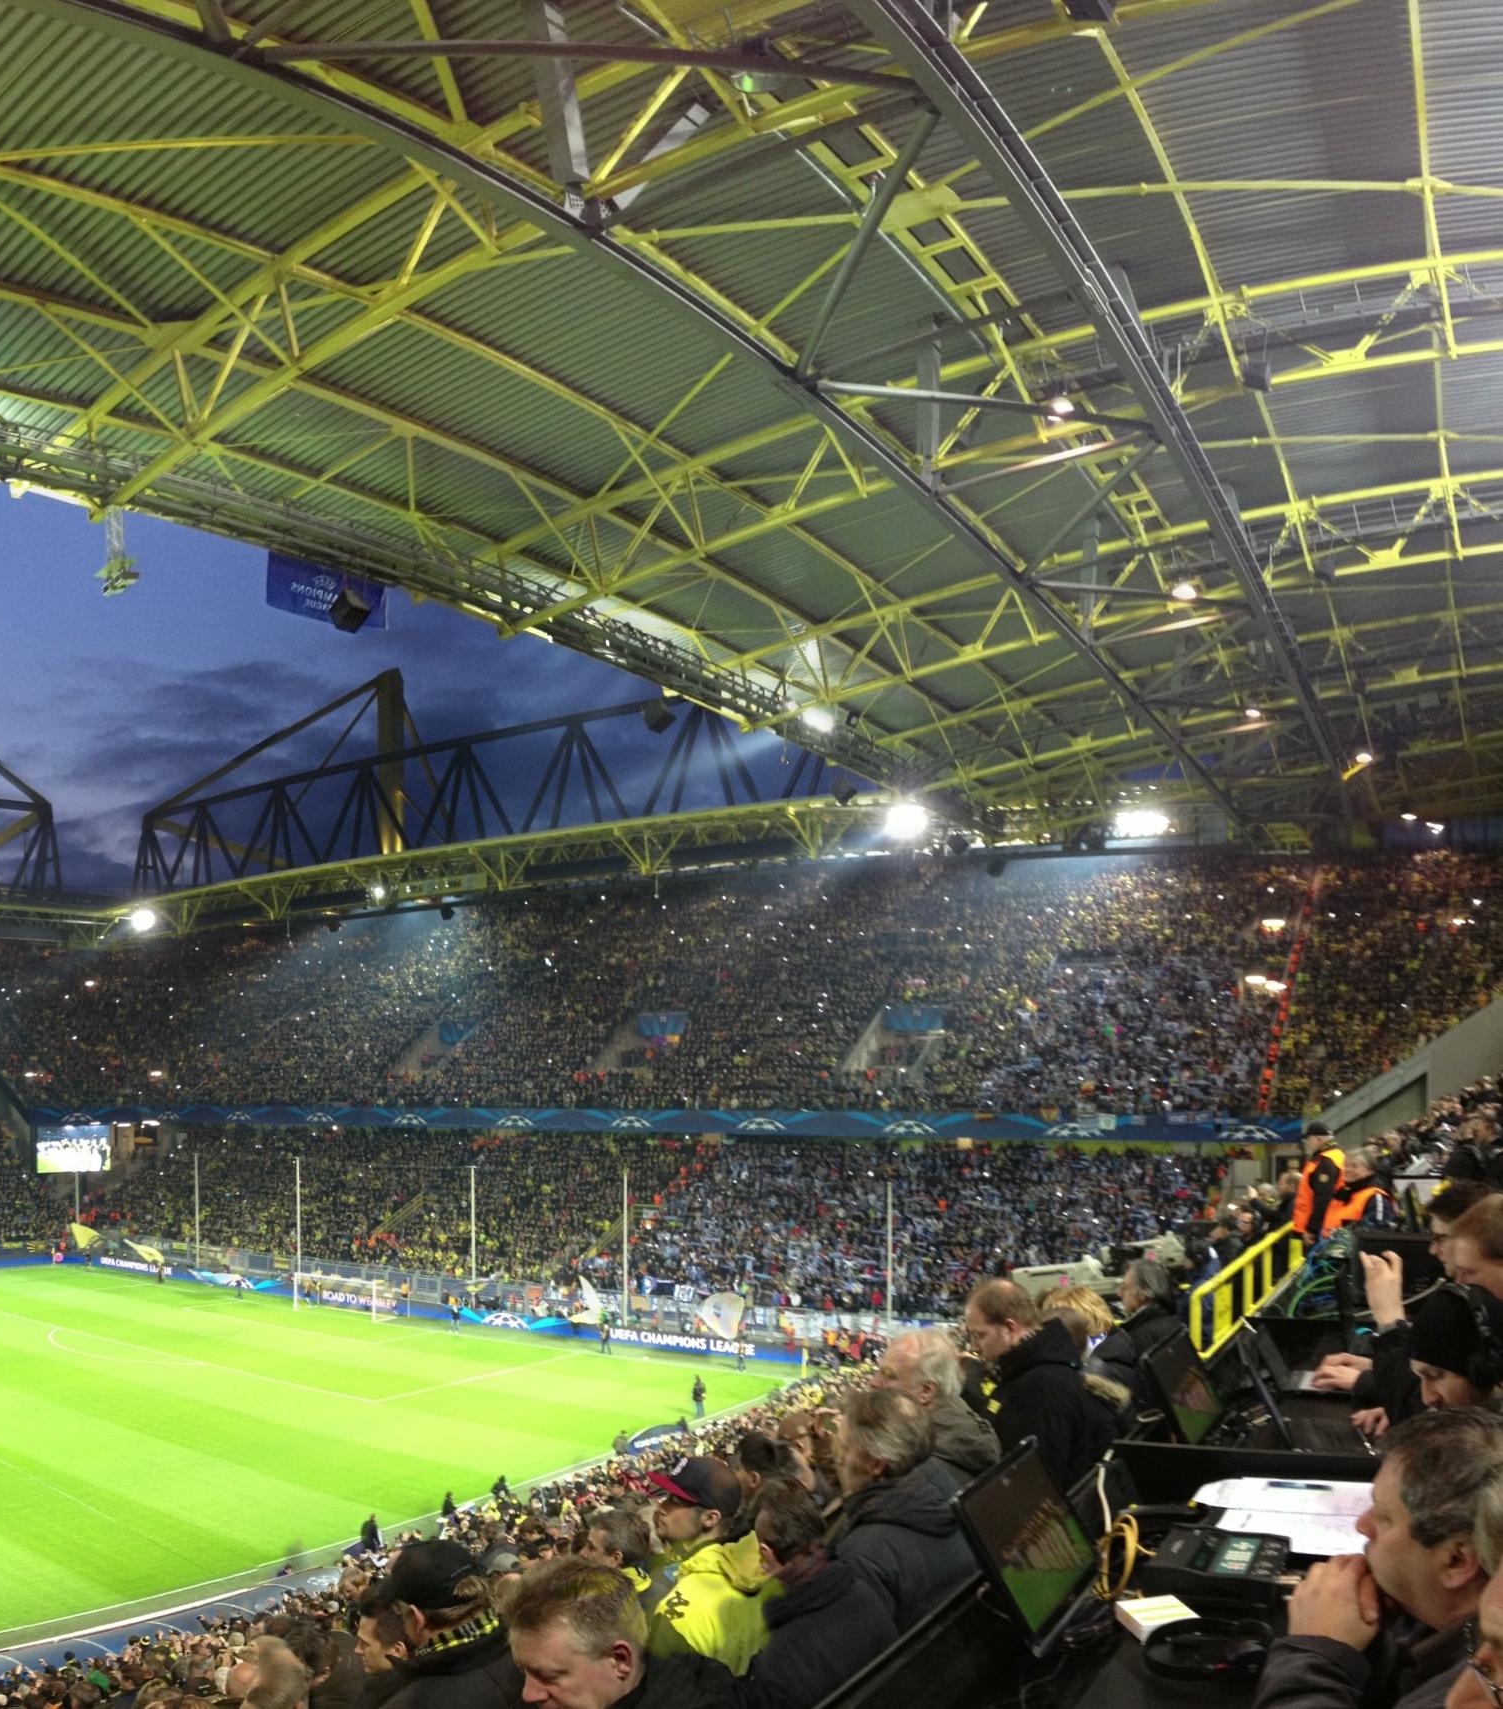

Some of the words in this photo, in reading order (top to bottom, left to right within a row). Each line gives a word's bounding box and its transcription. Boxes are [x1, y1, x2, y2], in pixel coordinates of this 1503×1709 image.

[149, 1264, 173, 1276] LEAUE
[322, 1289, 345, 1303] ROAD
[345, 1292, 357, 1305] TO
[609, 1326, 639, 1343] UEFA
[640, 1331, 707, 1350] CHAMPIONS
